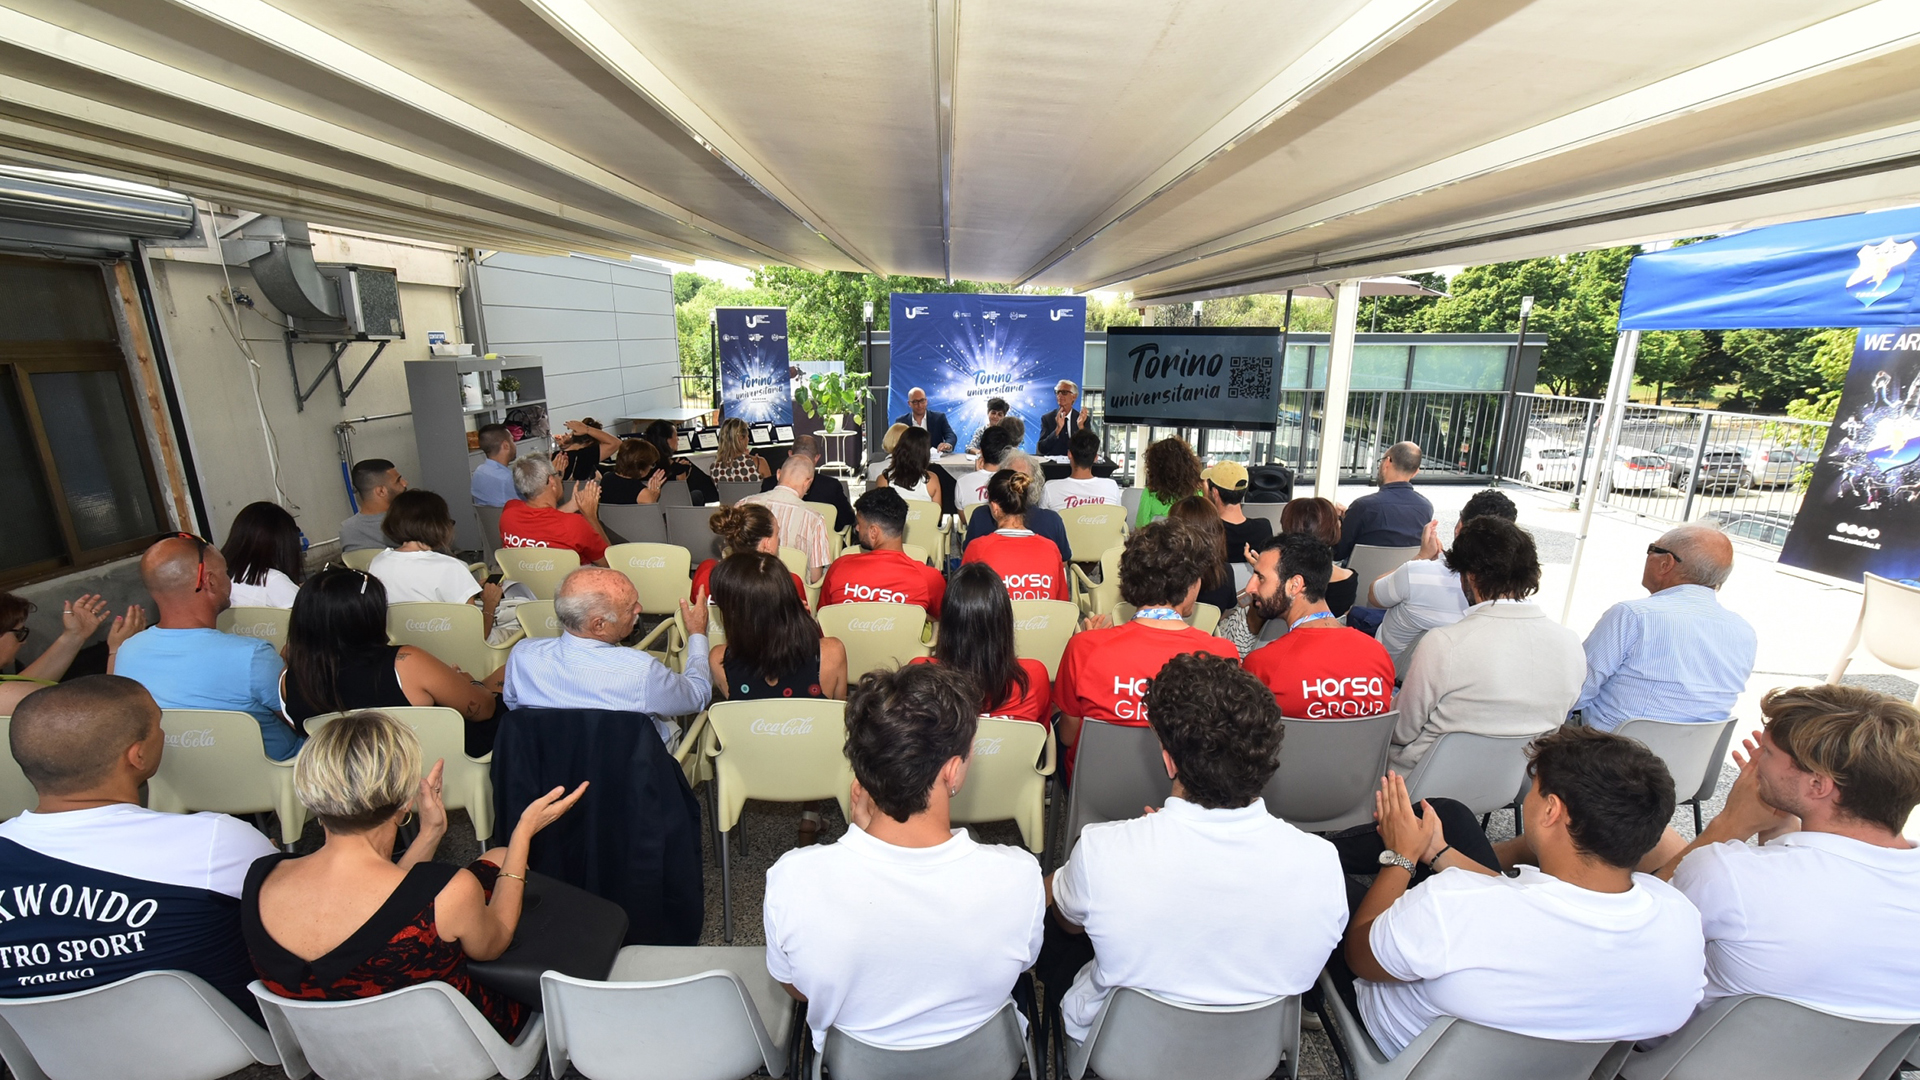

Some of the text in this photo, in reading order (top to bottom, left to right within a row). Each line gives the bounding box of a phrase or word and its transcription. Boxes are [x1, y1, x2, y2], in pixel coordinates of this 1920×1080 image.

[1864, 333, 1920, 351] WE AR
[1128, 342, 1223, 383] Torino
[739, 374, 772, 390] Torino
[973, 369, 1012, 386] Torino
[736, 386, 783, 400] universitaria
[967, 384, 1024, 397] universitaria
[1111, 383, 1221, 409] universitaria
[1064, 495, 1105, 509] Torino
[1077, 514, 1108, 524] Coca-Cola
[518, 559, 555, 572] Coca-Cola
[628, 556, 666, 568] Coca-Cola
[232, 621, 278, 637] Coca-Cola
[405, 617, 452, 633] Coca-Cola
[848, 616, 896, 632] Coca-Cola
[1302, 677, 1383, 699] Horsa
[749, 716, 815, 736] Coca-Cola
[57, 930, 147, 963] SPORT
[18, 967, 95, 986] TORINO
